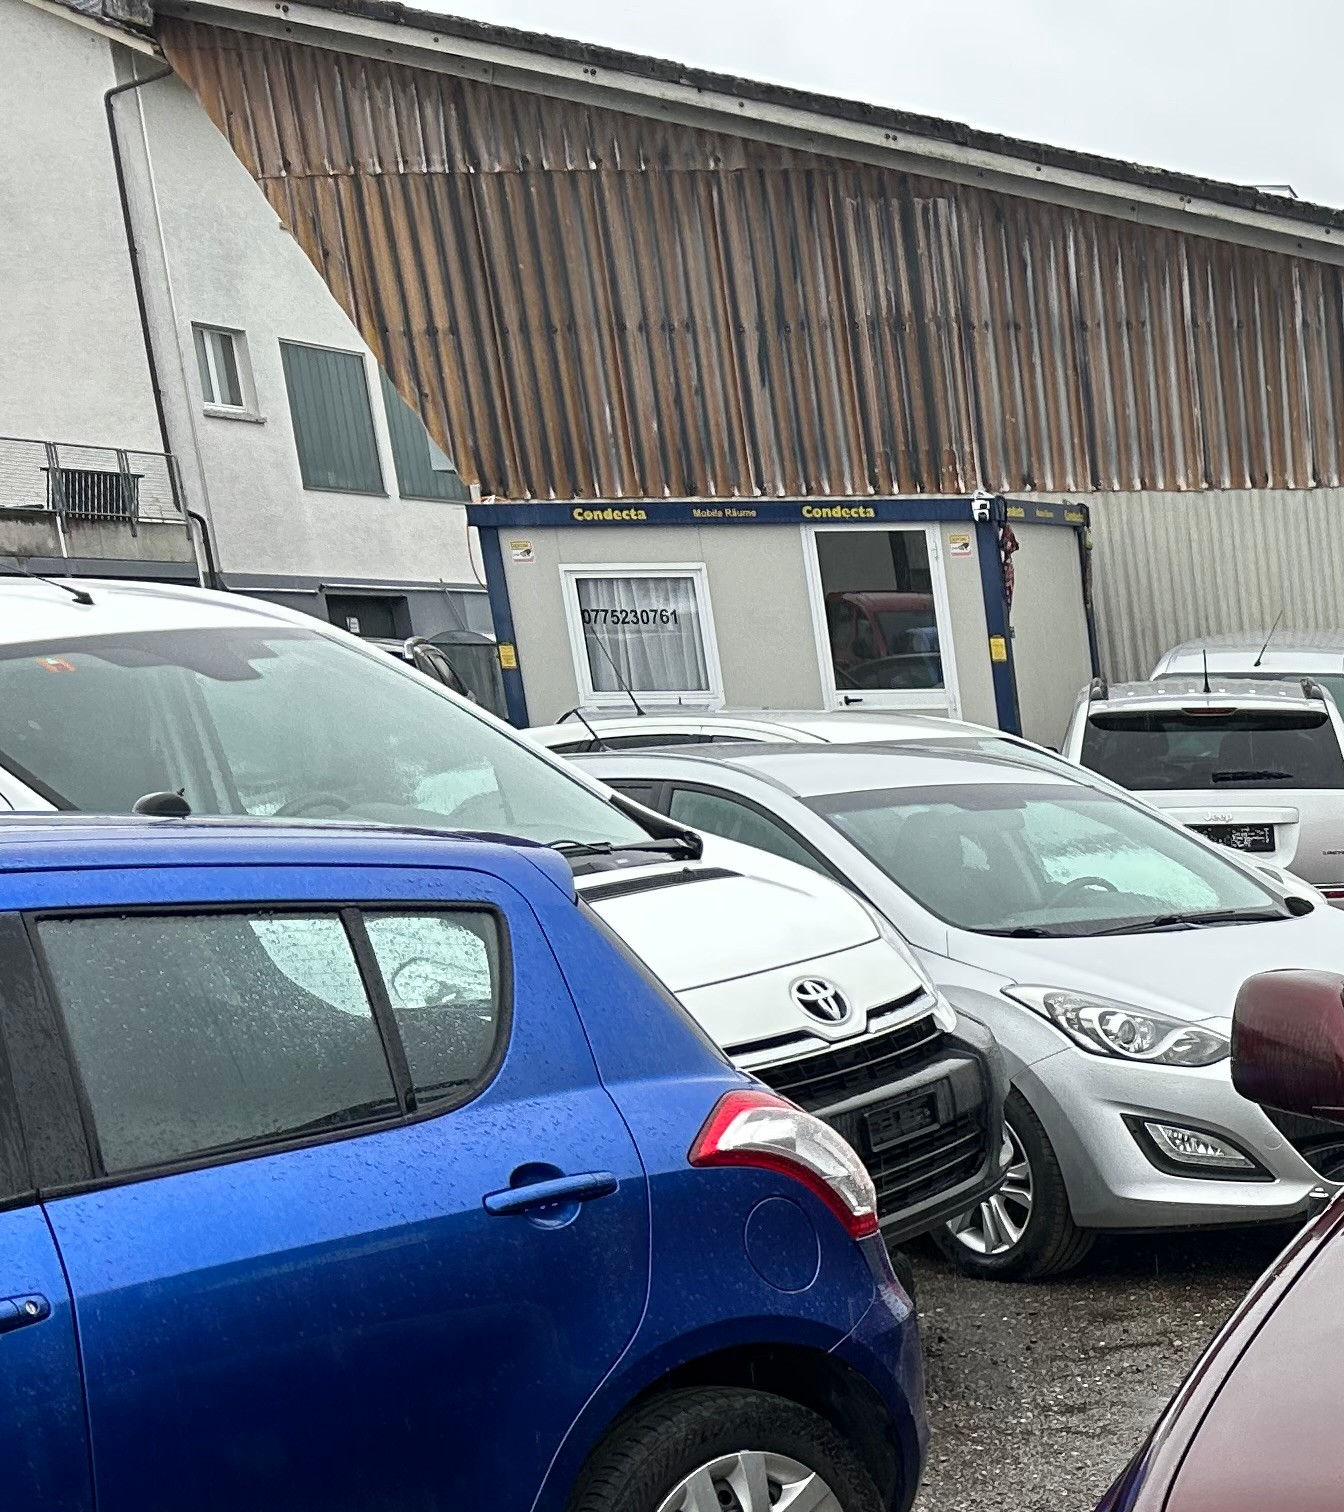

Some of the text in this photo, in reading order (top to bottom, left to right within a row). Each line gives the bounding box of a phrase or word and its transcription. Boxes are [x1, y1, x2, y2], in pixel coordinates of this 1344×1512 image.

[573, 508, 646, 520] Condecta
[802, 505, 875, 518] Condecta
[582, 609, 678, 624] 0775230761
[1204, 811, 1232, 822] Jeep
